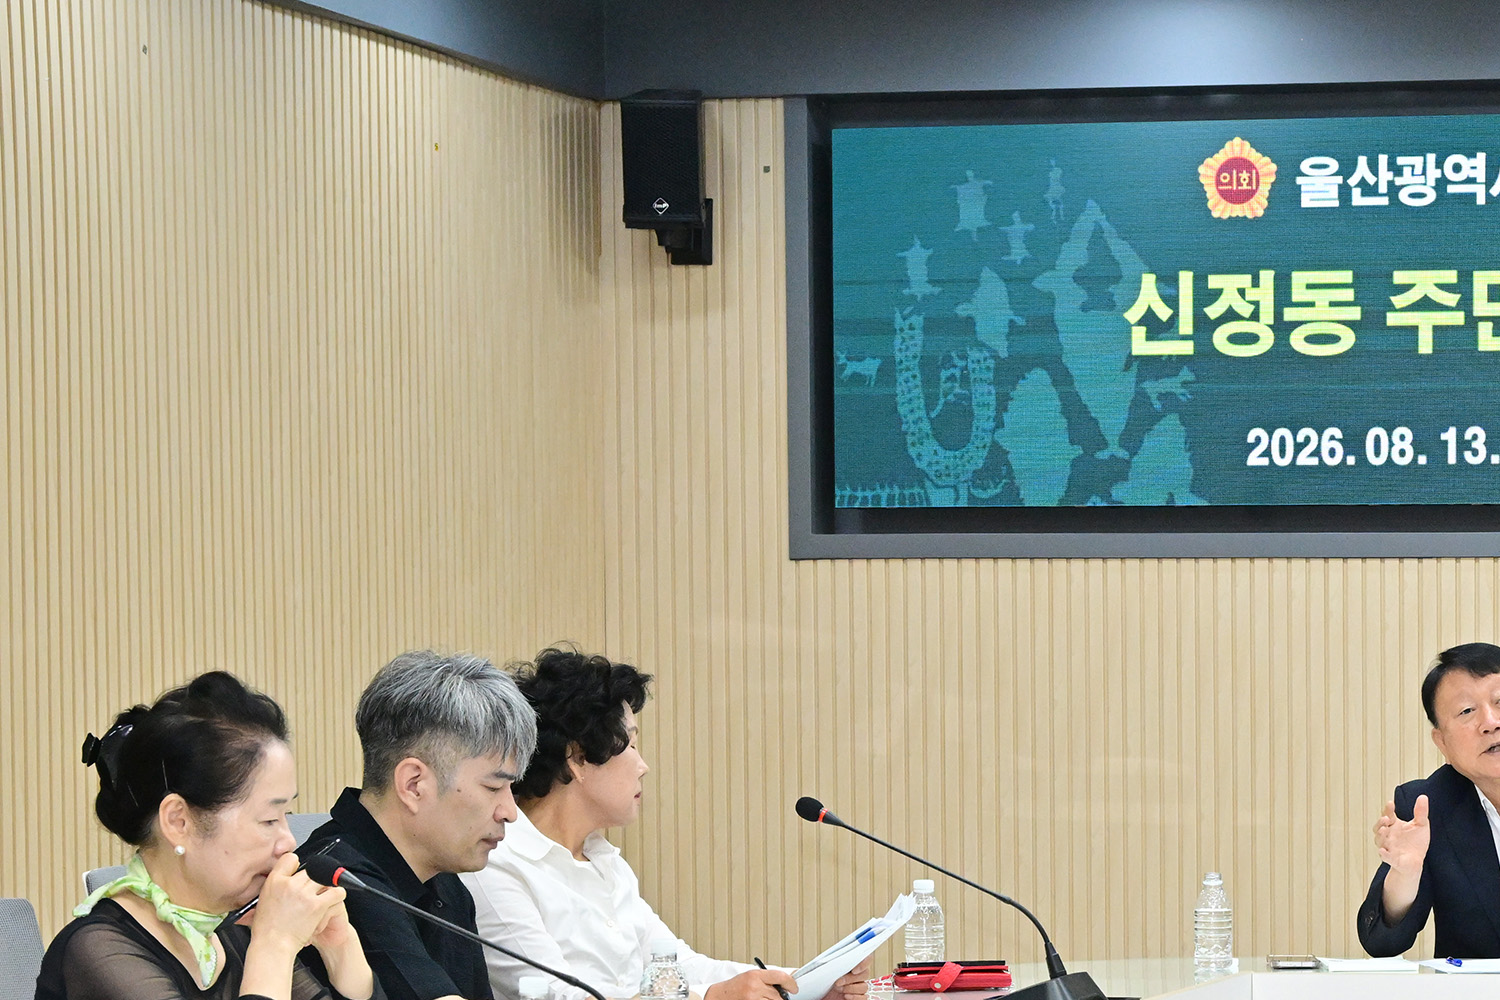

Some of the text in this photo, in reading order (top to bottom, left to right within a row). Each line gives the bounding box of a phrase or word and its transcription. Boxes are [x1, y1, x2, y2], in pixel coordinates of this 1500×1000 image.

[1217, 169, 1256, 190] 의회
[1122, 269, 1362, 358] 신정동
[1246, 427, 1356, 467] 2026.
[1365, 426, 1427, 466] 08.
